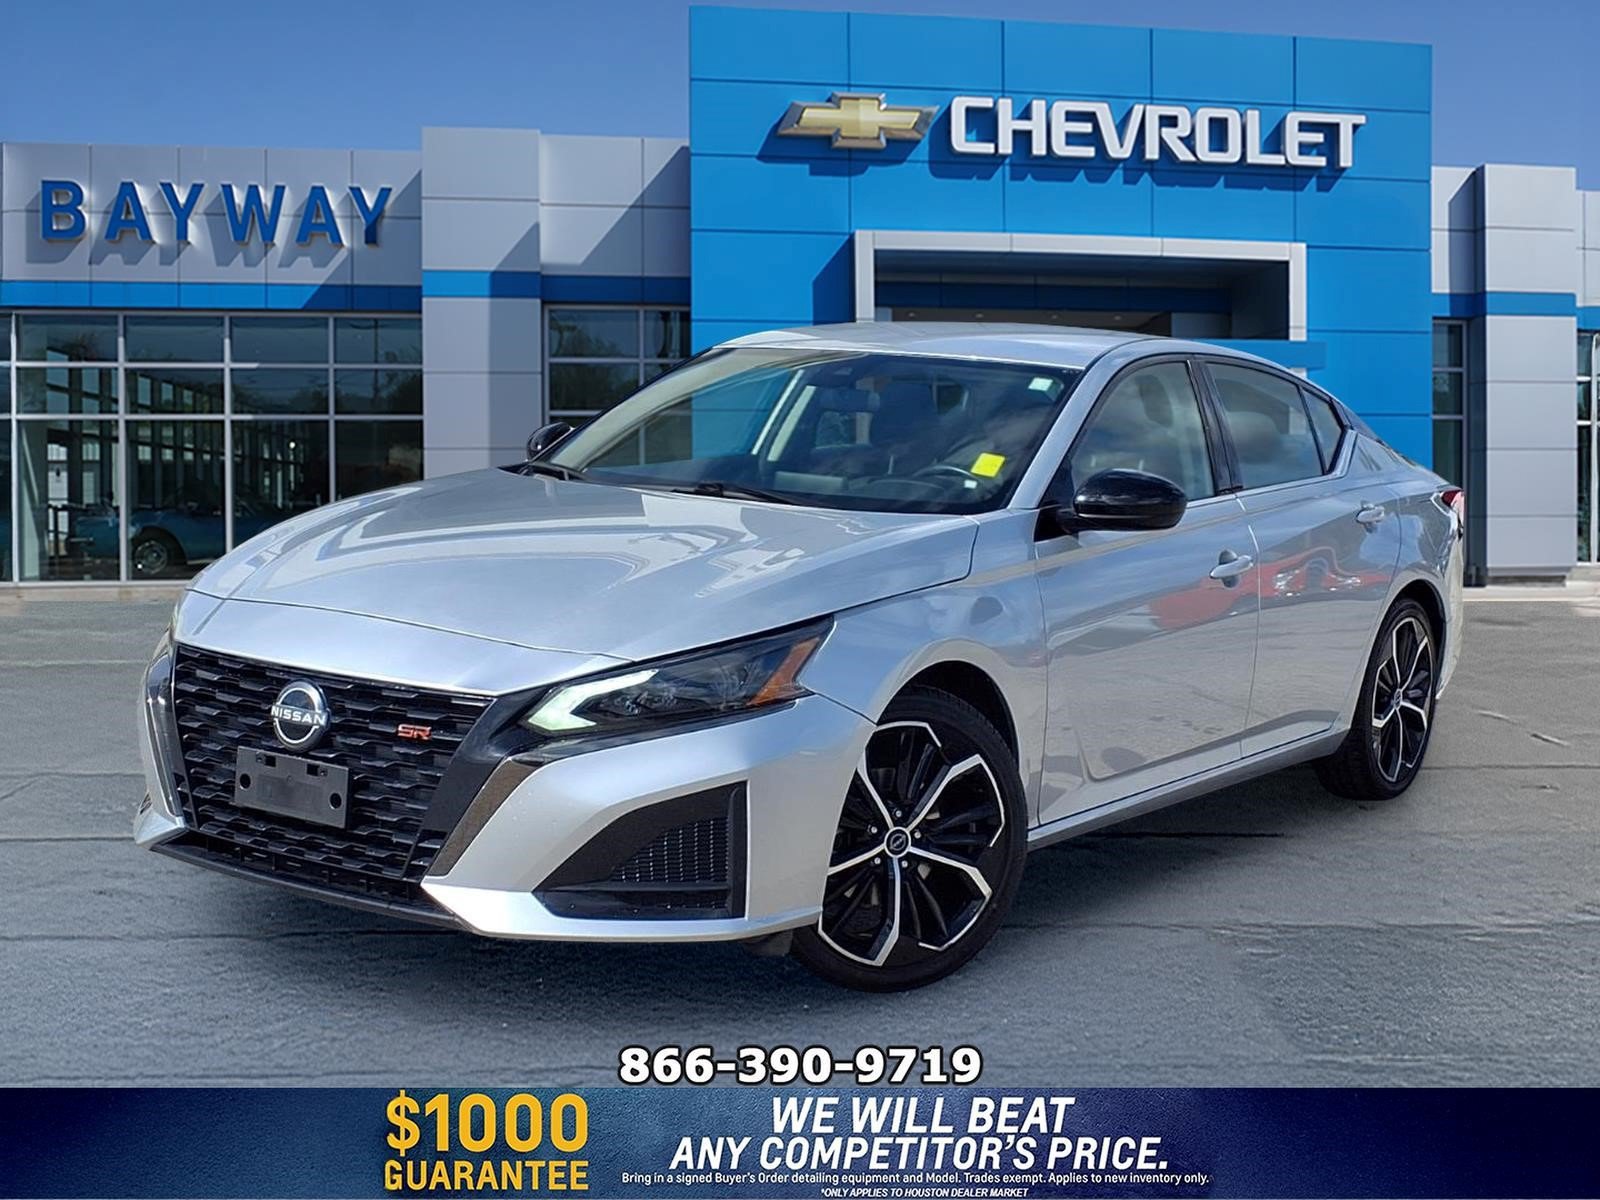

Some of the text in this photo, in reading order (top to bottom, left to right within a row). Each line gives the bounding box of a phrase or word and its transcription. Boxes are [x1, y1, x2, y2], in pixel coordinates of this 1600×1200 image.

[950, 96, 1366, 168] CHEVROLET
[40, 179, 392, 246] BAYWAY
[271, 706, 328, 726] NISSAN
[397, 723, 433, 740] SR
